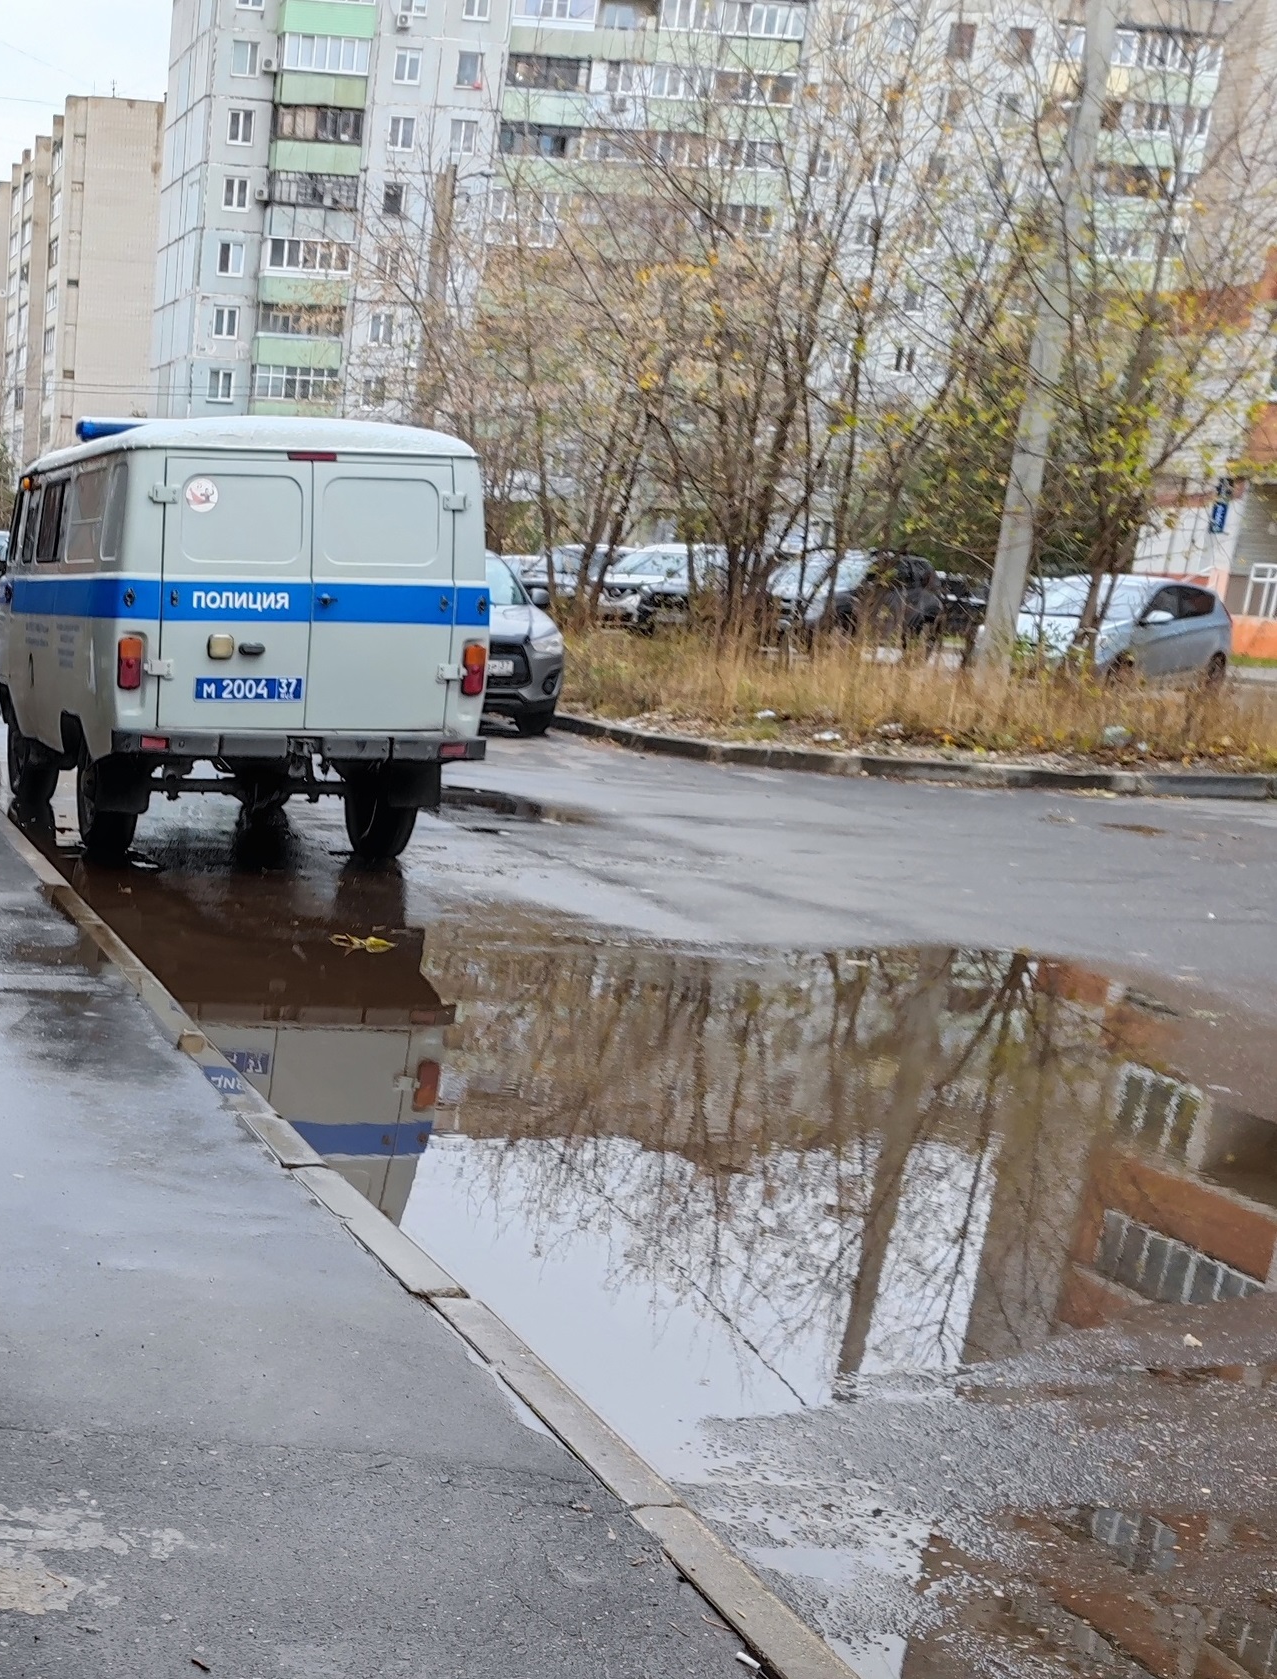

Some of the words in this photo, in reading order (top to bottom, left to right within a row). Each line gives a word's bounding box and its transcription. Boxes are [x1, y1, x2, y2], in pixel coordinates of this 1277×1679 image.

[192, 590, 289, 612] ПОЛИЦИЯ
[203, 682, 216, 698] М
[222, 679, 268, 699] 2004
[278, 679, 297, 693] 37
